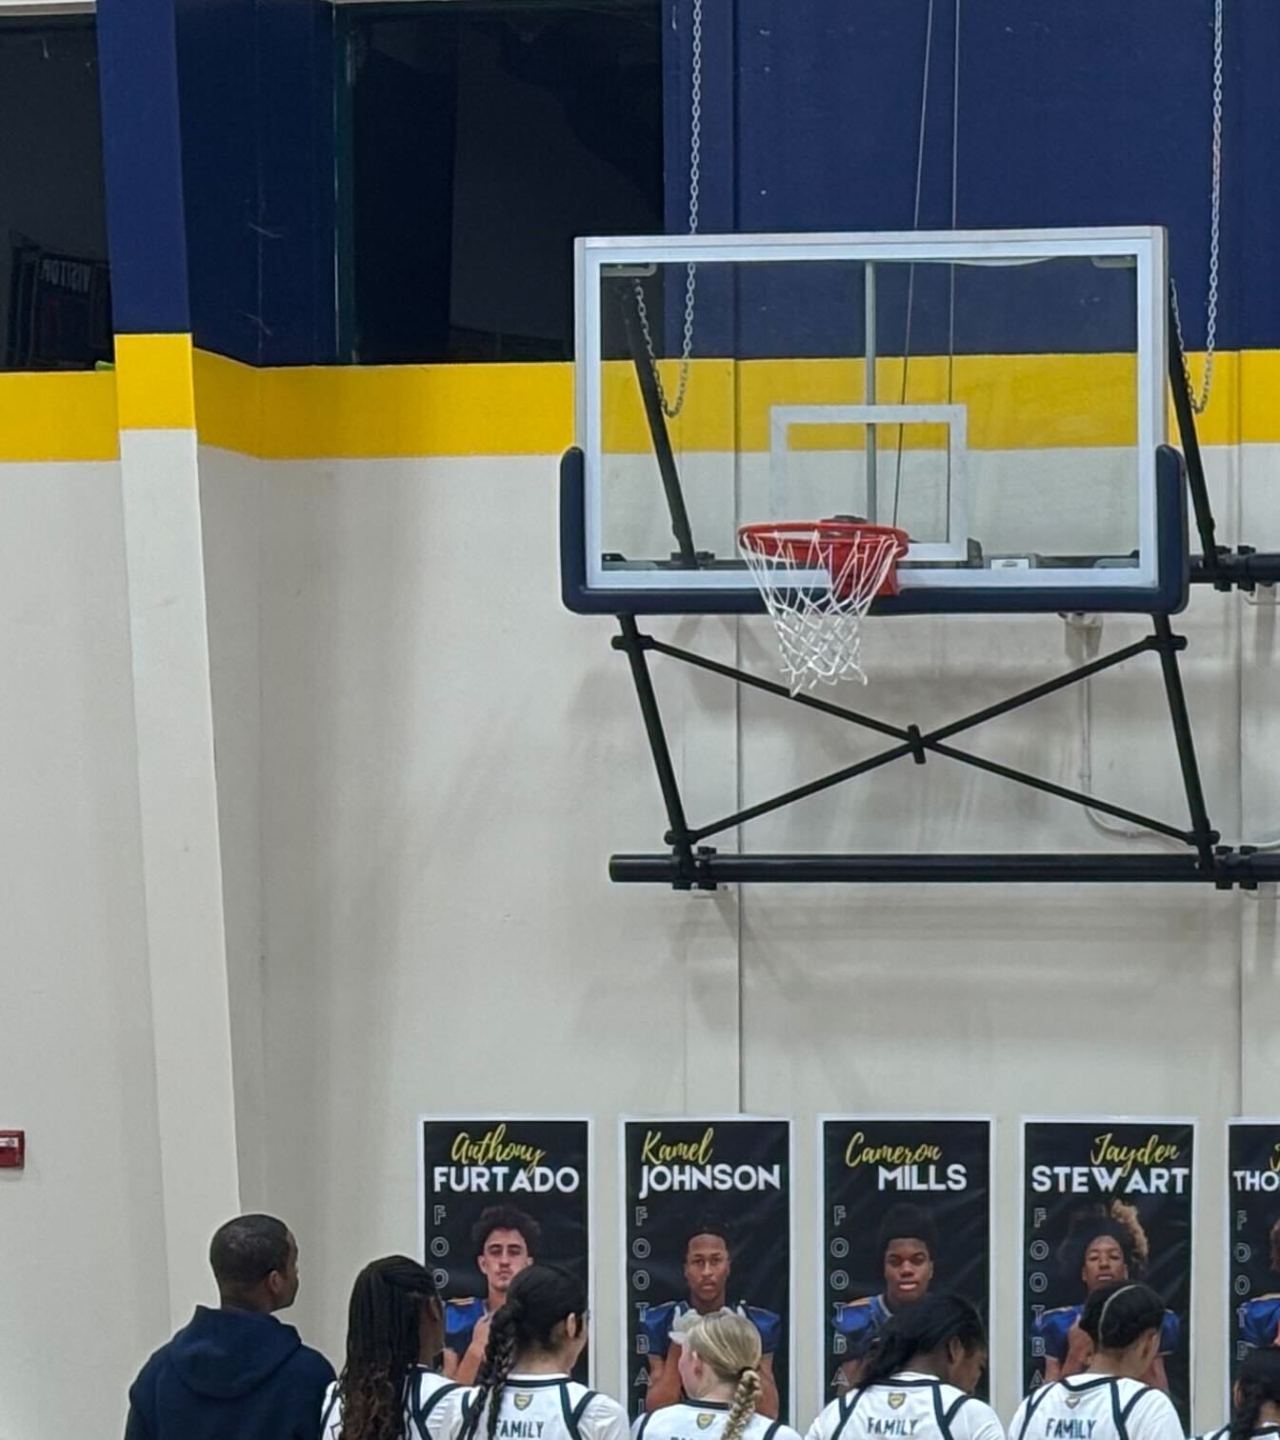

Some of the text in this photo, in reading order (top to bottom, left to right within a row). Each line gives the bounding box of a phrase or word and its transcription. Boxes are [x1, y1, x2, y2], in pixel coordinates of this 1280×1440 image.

[451, 1124, 546, 1177] Anthony
[844, 1131, 942, 1169] Cameron
[1089, 1133, 1180, 1179] Jayden
[433, 1164, 580, 1194] FURTADO
[638, 1164, 781, 1199] JOHNSON
[877, 1166, 968, 1192] MILLS
[1031, 1165, 1190, 1196] STEWART
[867, 1417, 919, 1437] FAMILY
[1045, 1418, 1098, 1440] FAMILY
